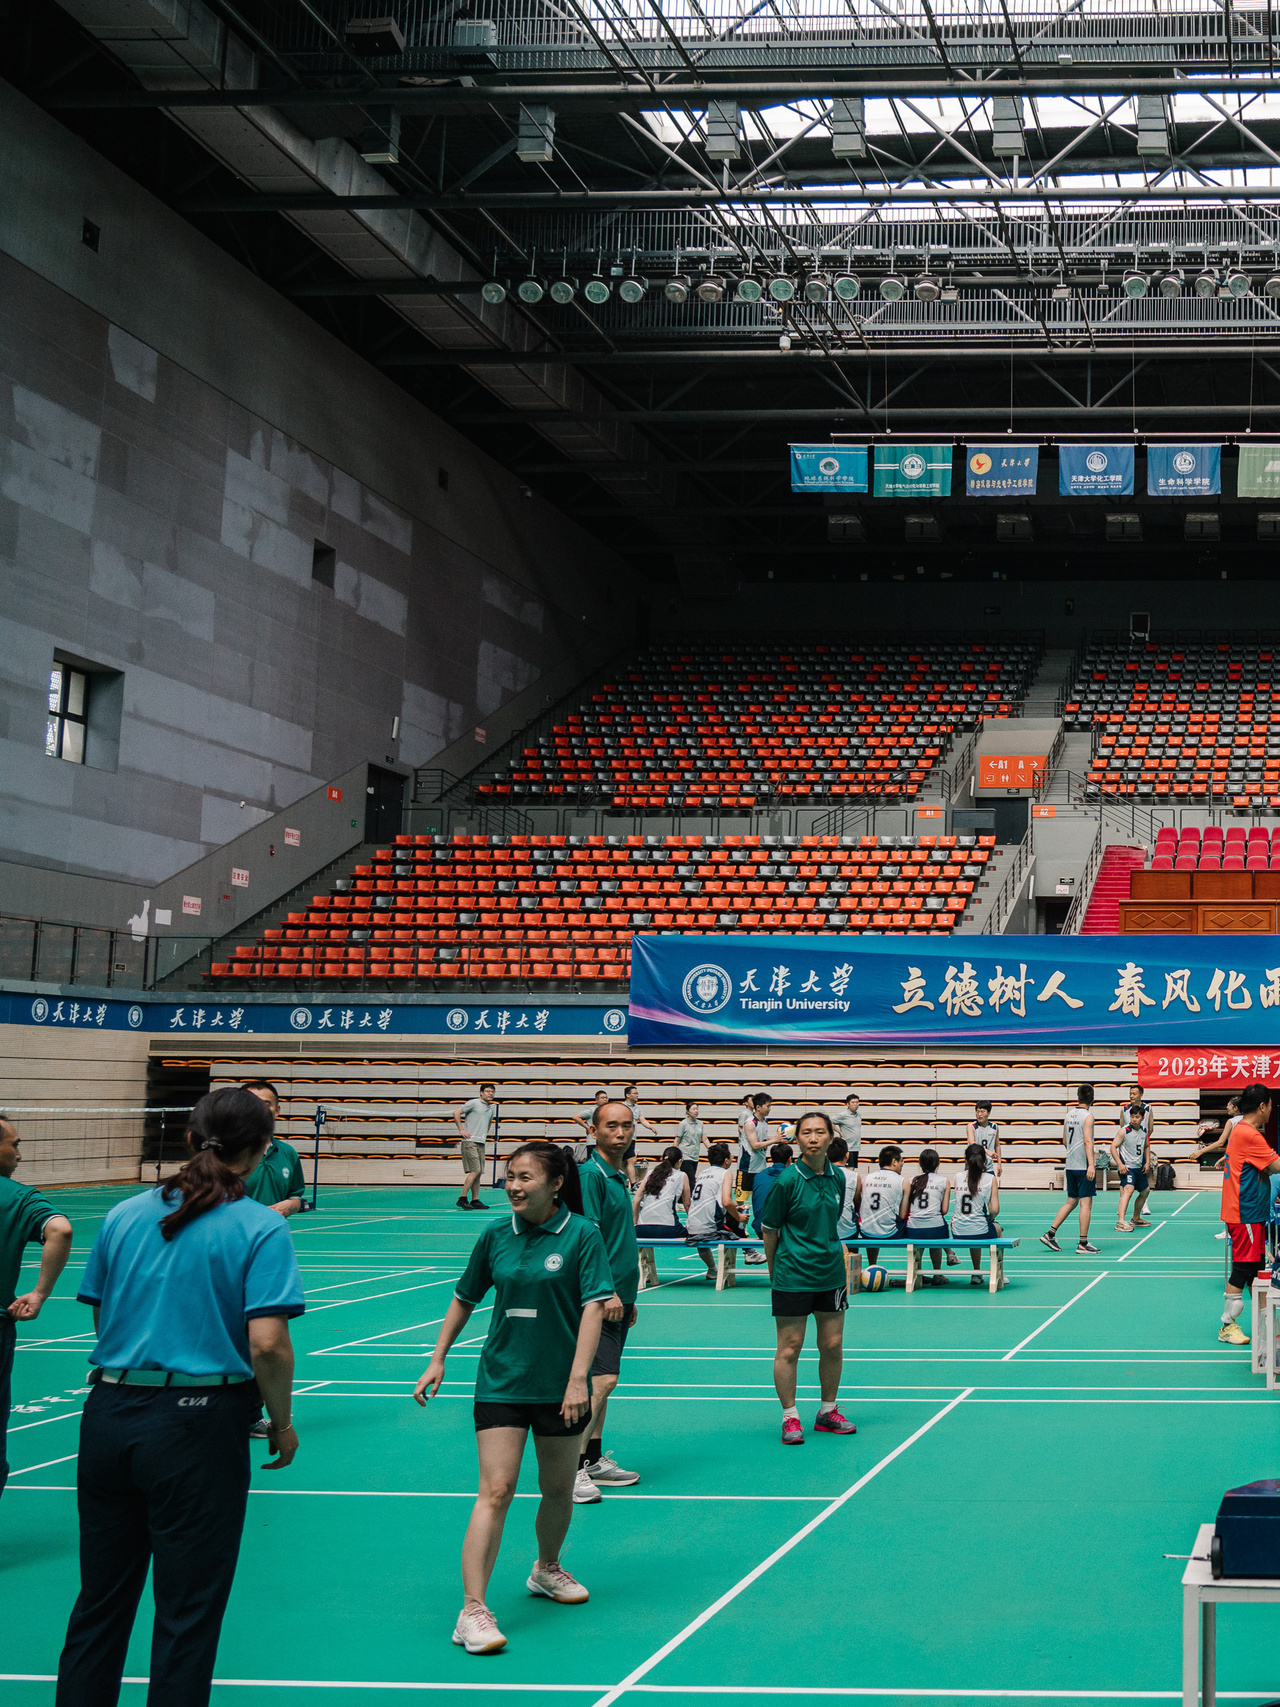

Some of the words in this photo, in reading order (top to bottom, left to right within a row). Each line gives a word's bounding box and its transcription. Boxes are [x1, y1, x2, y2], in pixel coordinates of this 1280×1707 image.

[1158, 477, 1211, 486] 生命科学学院
[998, 759, 1008, 770] A1
[739, 962, 854, 997] 天津大学
[892, 961, 1084, 1018] 立德树人
[52, 1002, 107, 1027] 天津大学
[740, 998, 783, 1013] Tianjin
[786, 998, 851, 1013] University
[169, 1007, 246, 1030] 天津大学
[317, 1008, 394, 1031] 天津大学
[474, 1008, 550, 1031] 天津大学
[1068, 1126, 1075, 1145] 7
[1136, 1144, 1142, 1156] 5
[692, 1183, 703, 1201] 9
[869, 1192, 881, 1211] 3
[918, 1191, 930, 1209] 8
[961, 1193, 973, 1215] 6
[177, 1396, 209, 1407] CVA
